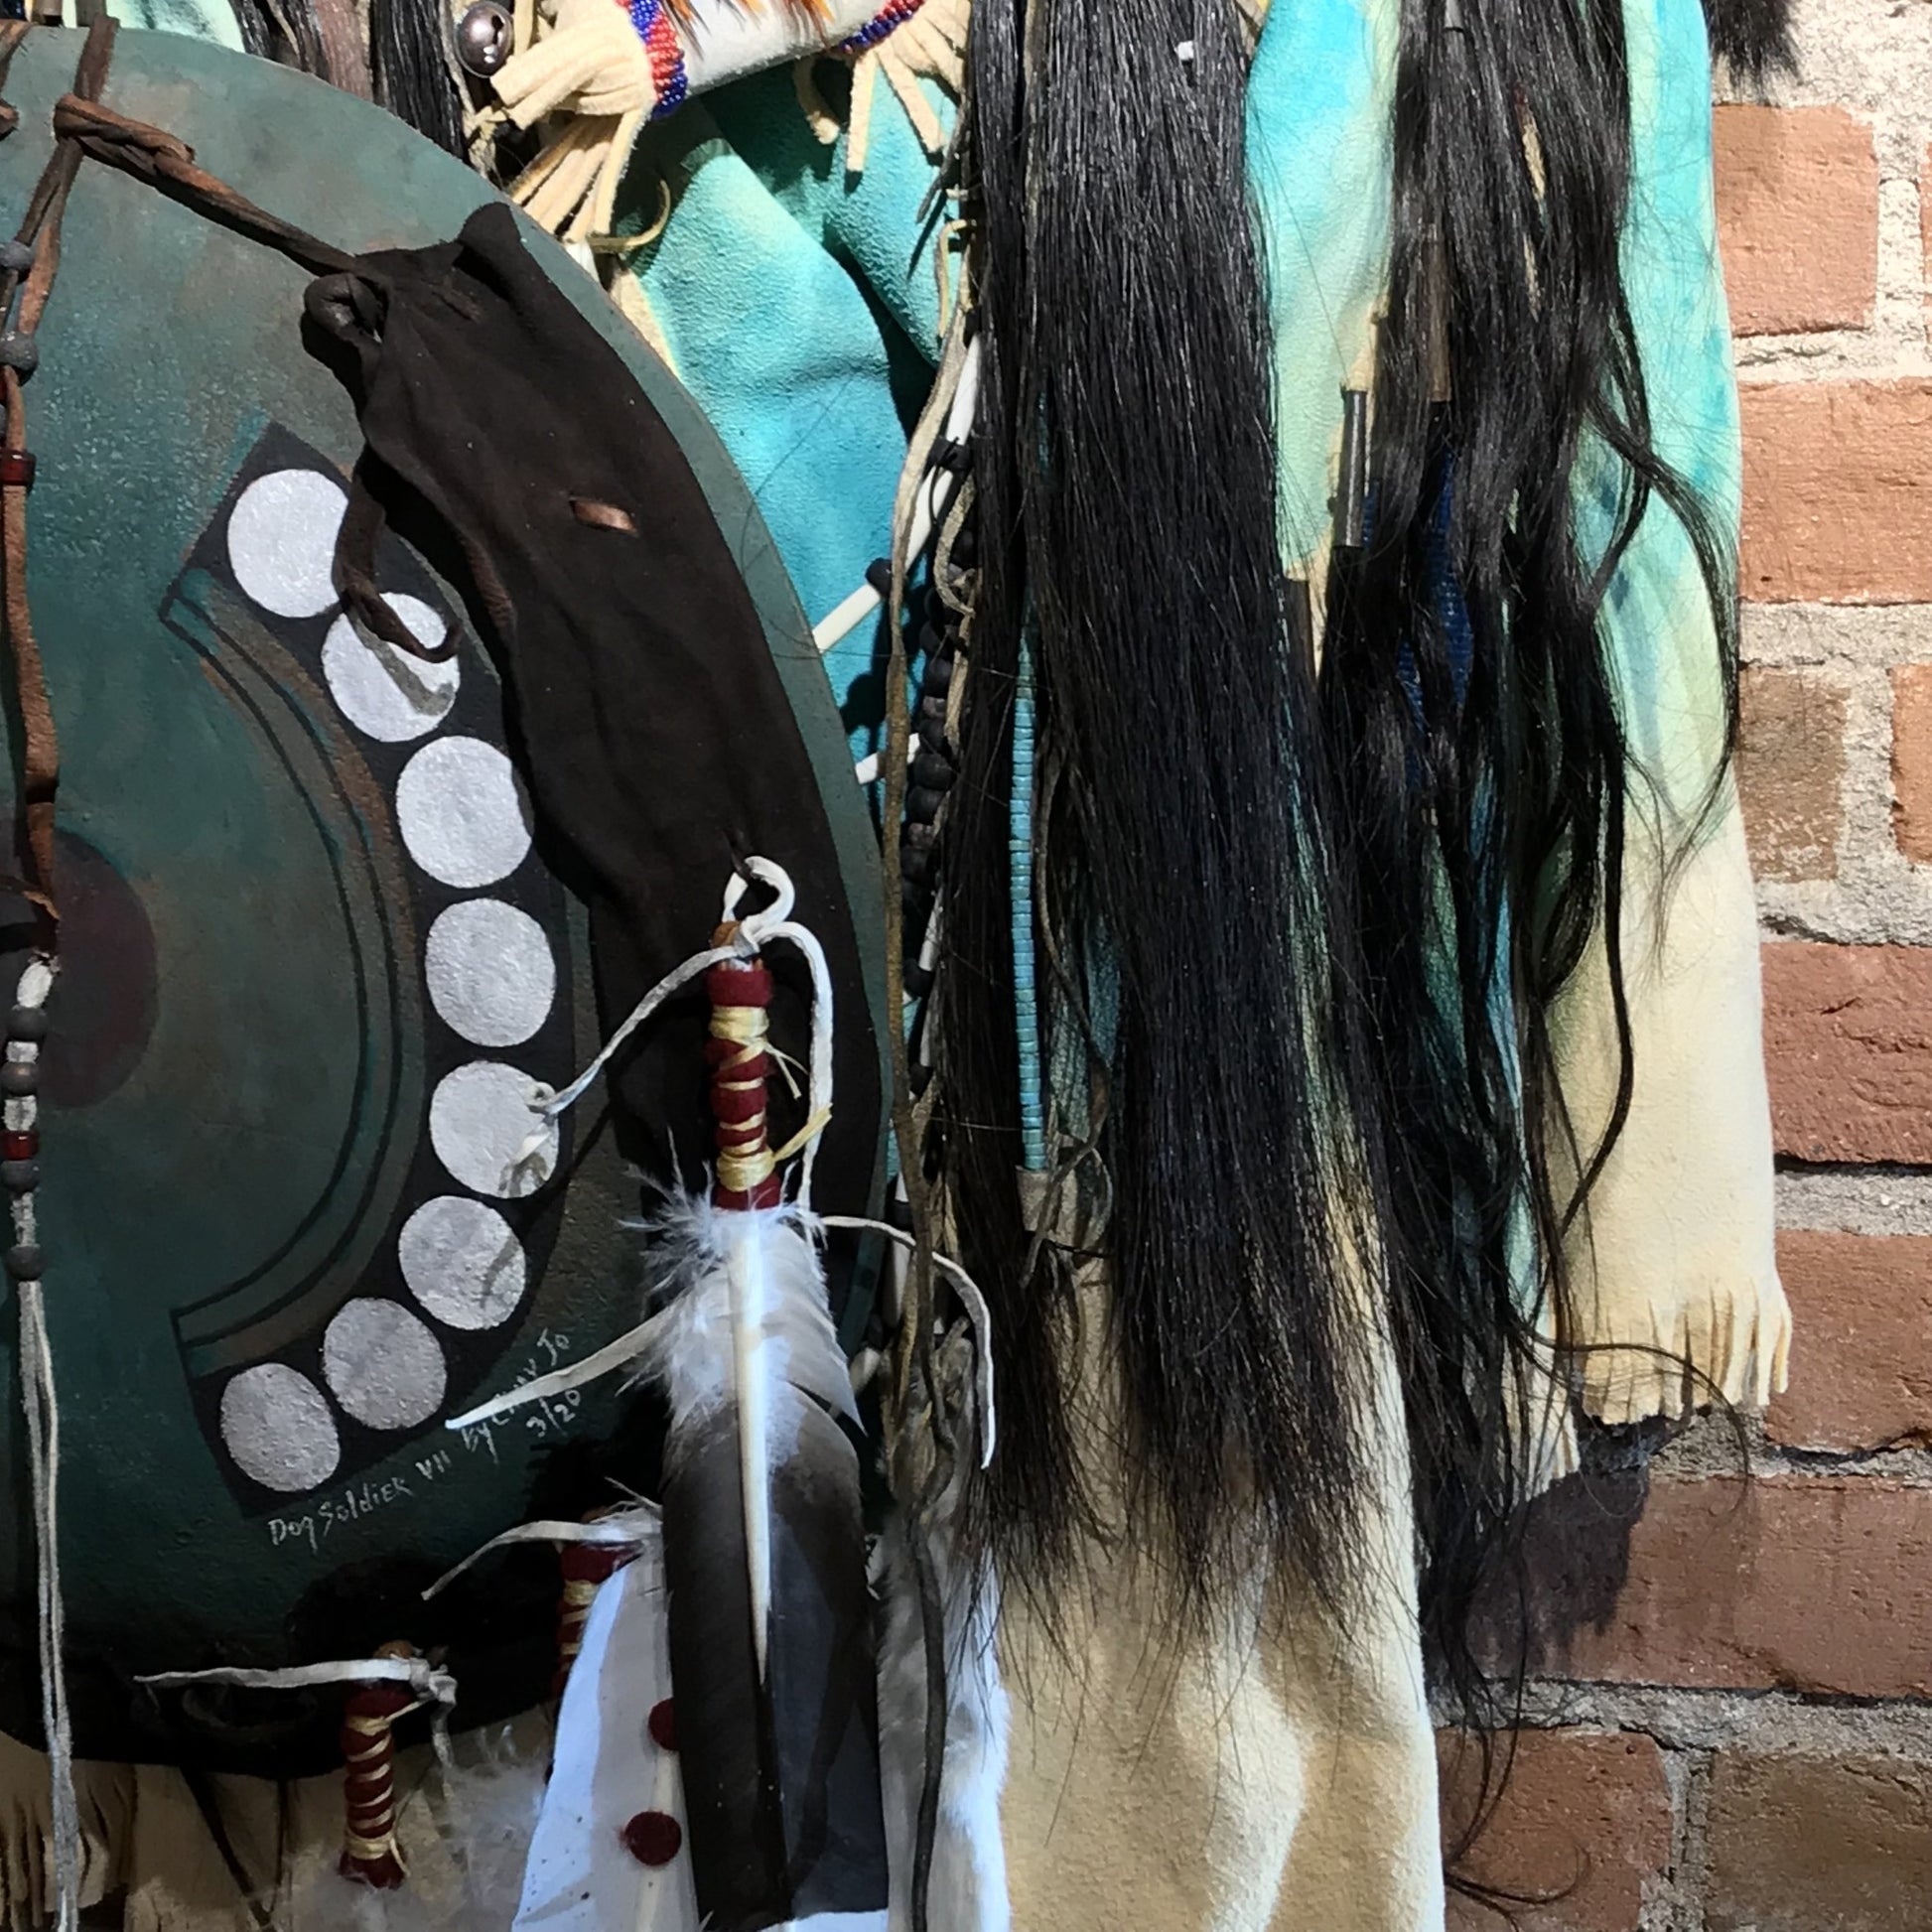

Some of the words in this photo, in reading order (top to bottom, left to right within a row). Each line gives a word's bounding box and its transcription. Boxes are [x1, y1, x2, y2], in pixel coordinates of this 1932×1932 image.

[525, 1389, 581, 1439] 3/20
[268, 1517, 318, 1555] Dog
[415, 1449, 452, 1480] VII
